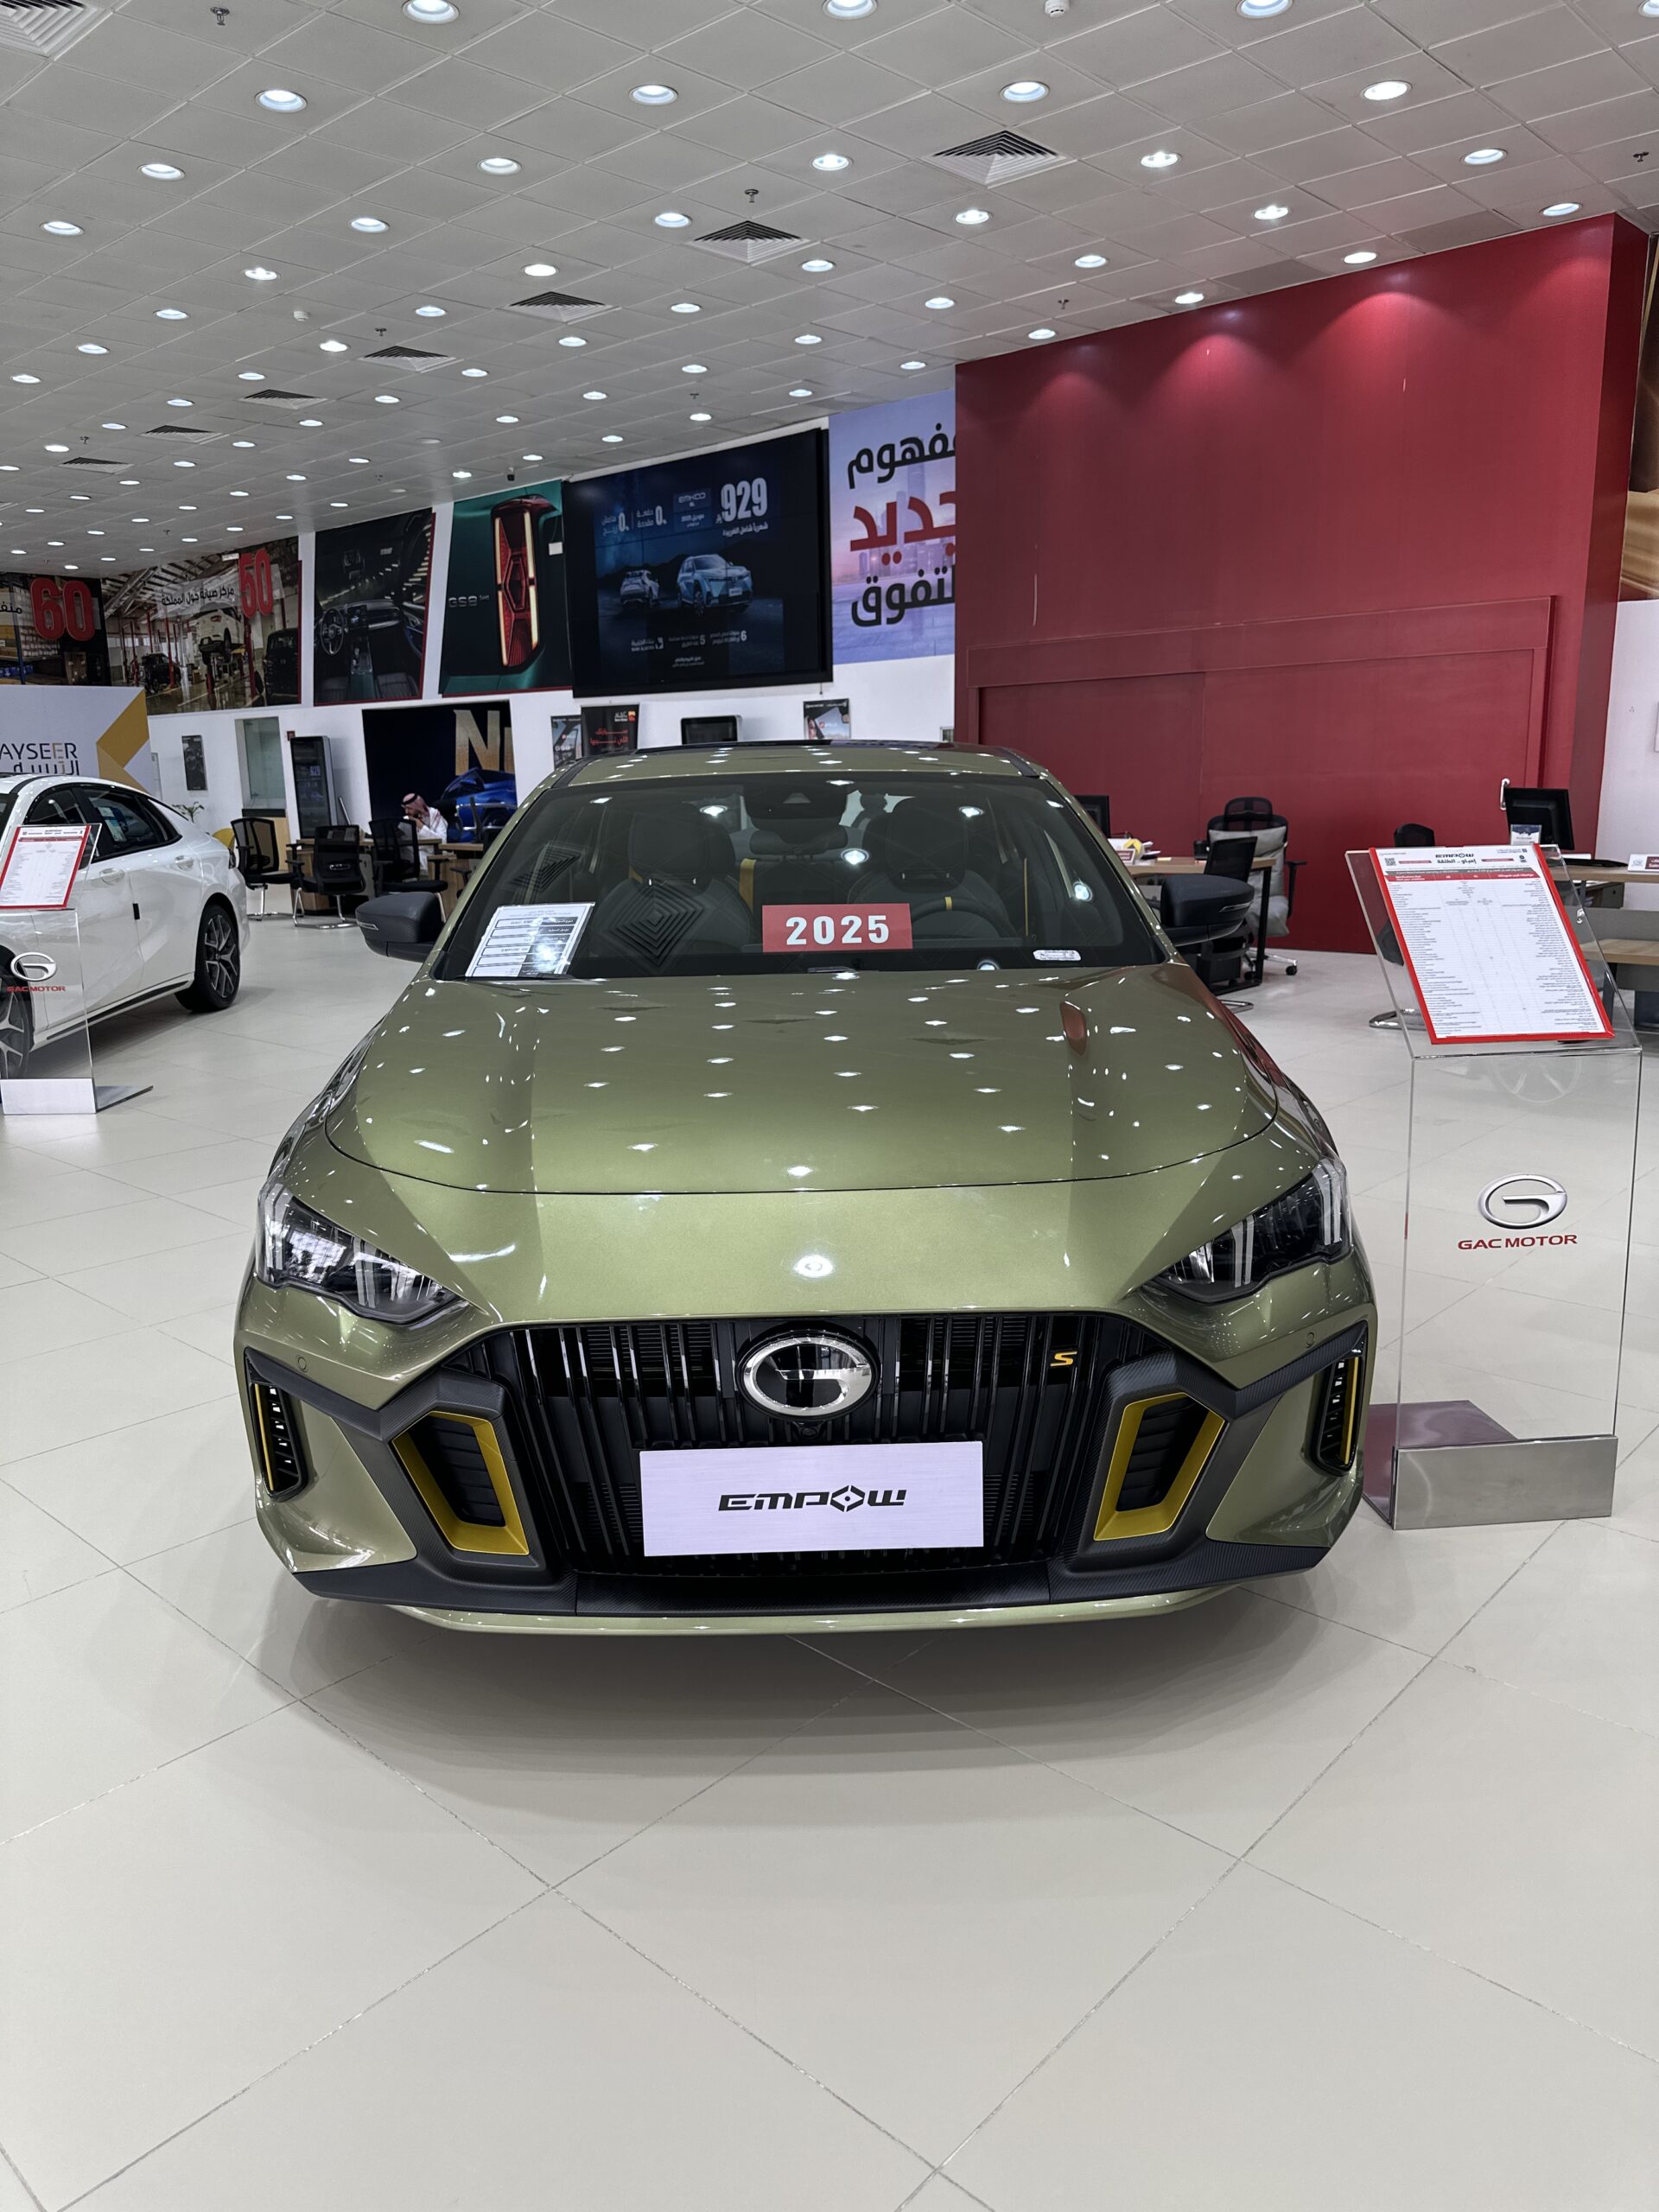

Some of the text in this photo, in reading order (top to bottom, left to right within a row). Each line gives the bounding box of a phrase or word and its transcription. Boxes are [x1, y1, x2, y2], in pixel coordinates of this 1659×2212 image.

[848, 423, 956, 489] فهوم
[721, 478, 768, 522] 929
[219, 585, 234, 599] مركز
[238, 548, 274, 618] 50
[30, 577, 95, 641] 60
[162, 593, 185, 607] المملكة
[785, 915, 889, 945] 2025
[1458, 1234, 1578, 1250] GAC MOTOR
[1050, 1350, 1077, 1368] S
[718, 1484, 907, 1513] EMPOW
